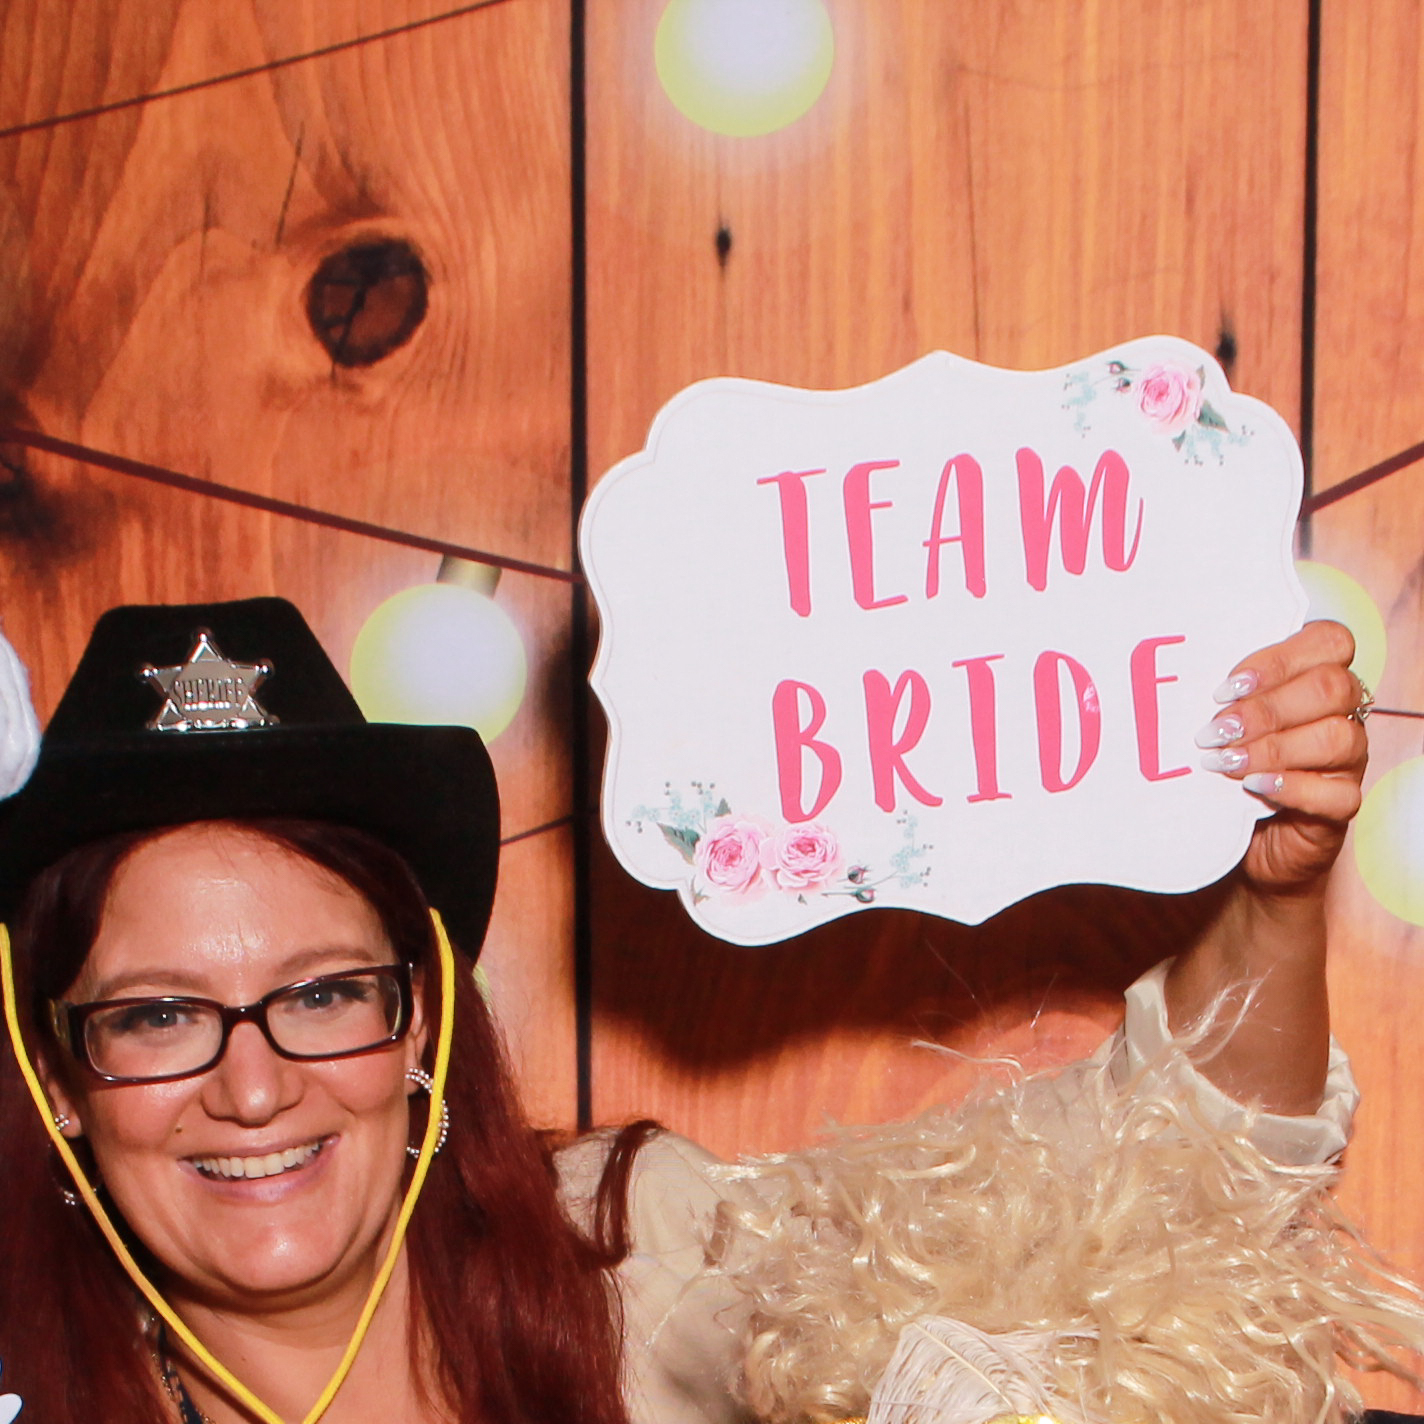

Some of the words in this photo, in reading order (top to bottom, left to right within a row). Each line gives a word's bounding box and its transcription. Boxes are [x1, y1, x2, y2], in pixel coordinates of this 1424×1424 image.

[756, 446, 1144, 618] TEAM
[173, 677, 244, 709] SHERIFF
[770, 634, 1194, 824] BRIDE
